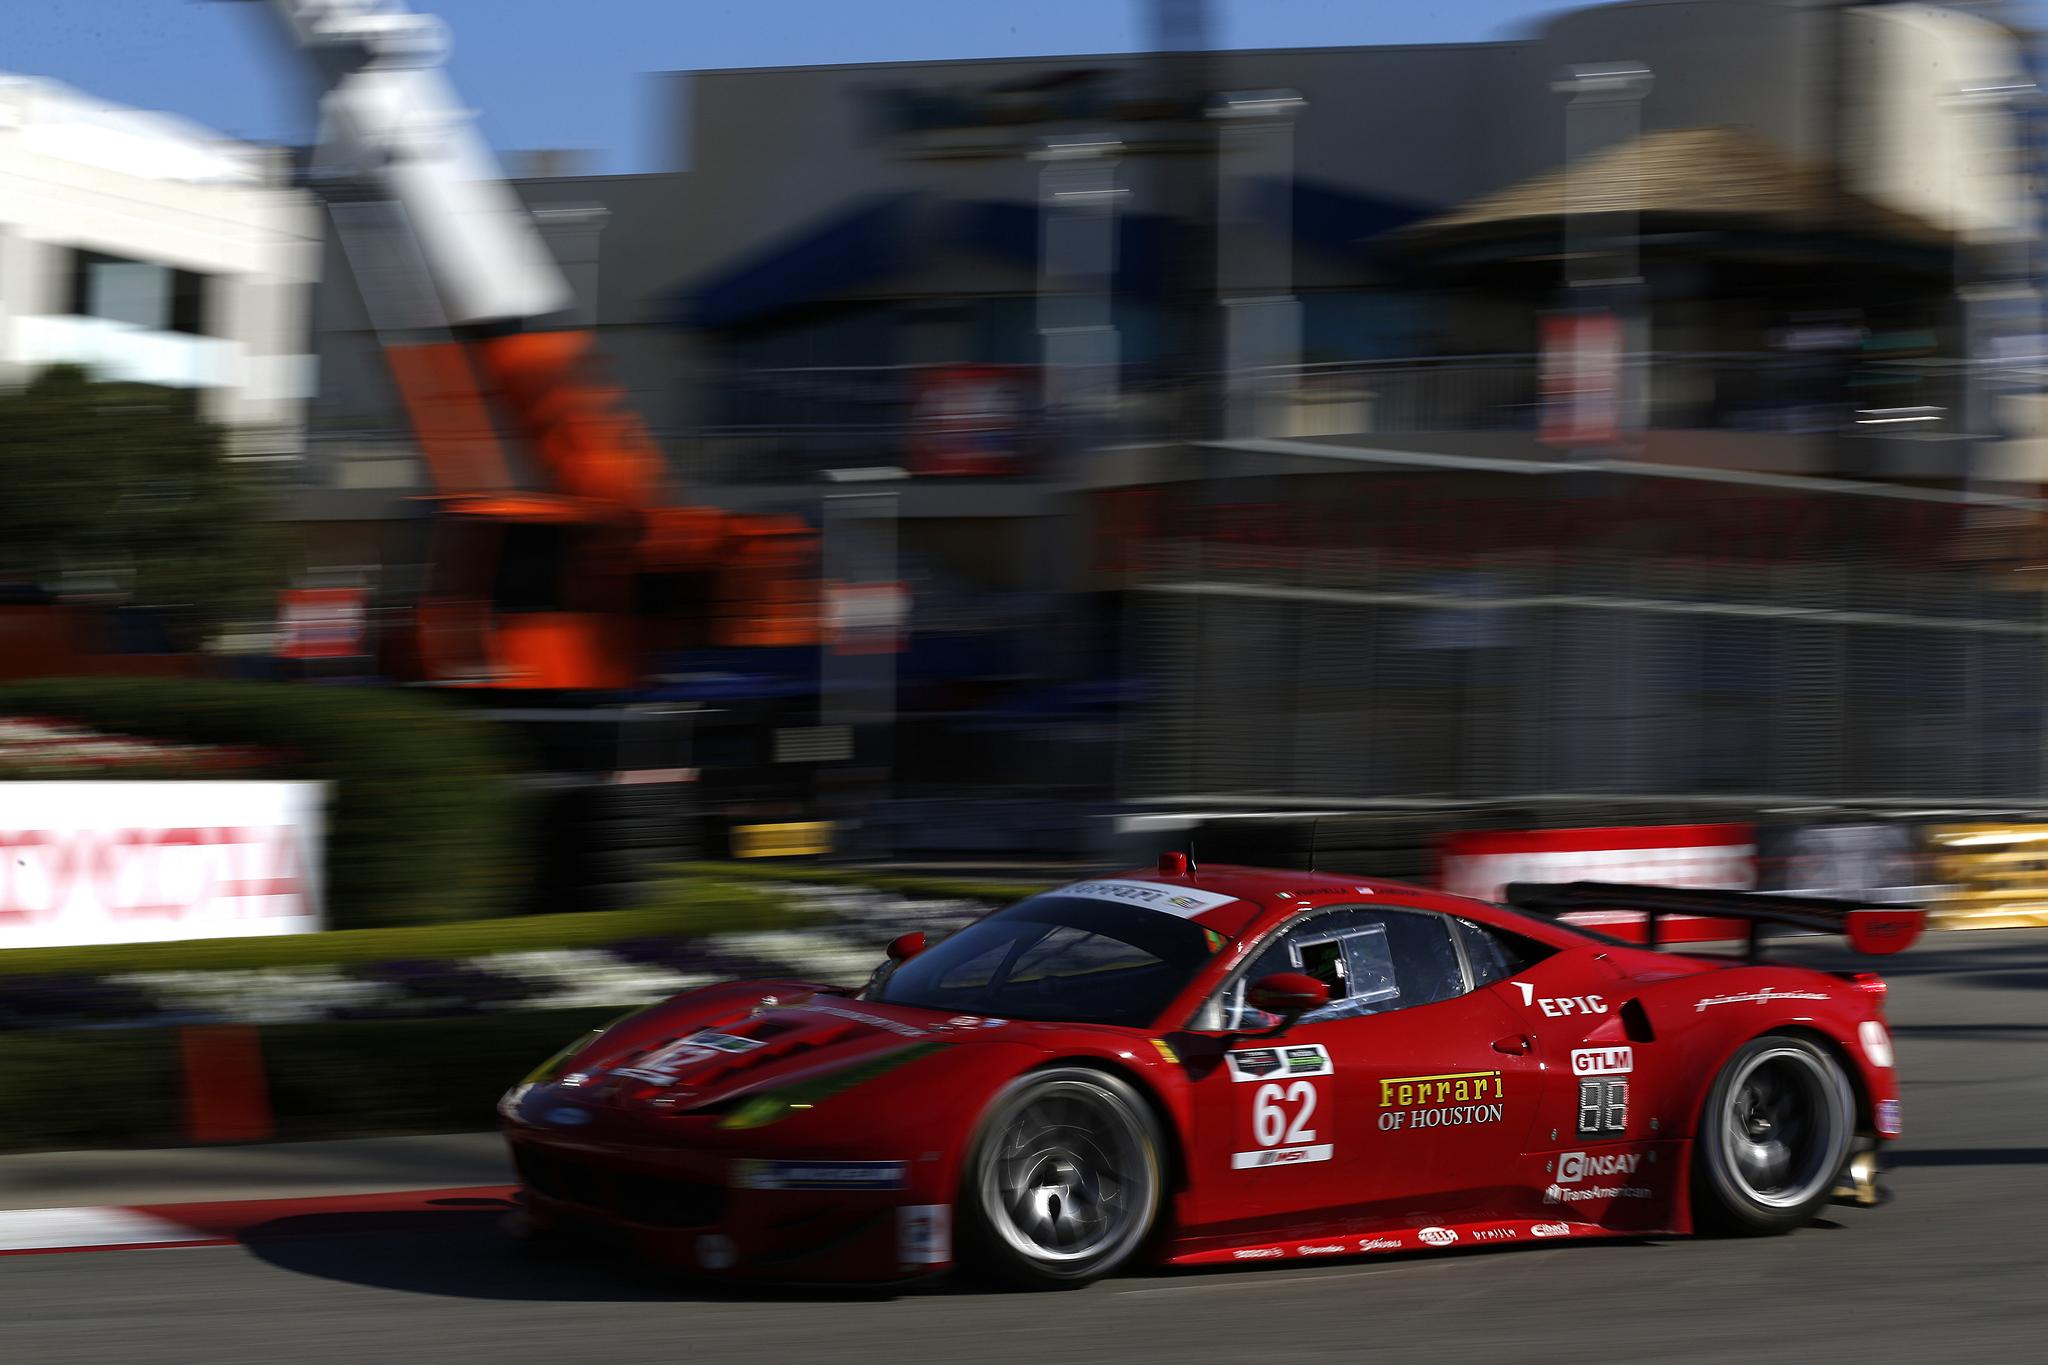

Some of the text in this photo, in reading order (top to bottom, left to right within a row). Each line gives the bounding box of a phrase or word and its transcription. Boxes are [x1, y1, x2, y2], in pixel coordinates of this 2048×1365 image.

[1537, 995, 1608, 1017] EPIC
[1575, 1051, 1630, 1072] GTLM
[1379, 1070, 1503, 1107] Ferrari
[1252, 1080, 1317, 1147] 62
[1378, 1104, 1503, 1130] OF HOUSTON
[1559, 1153, 1640, 1180] CINSAY
